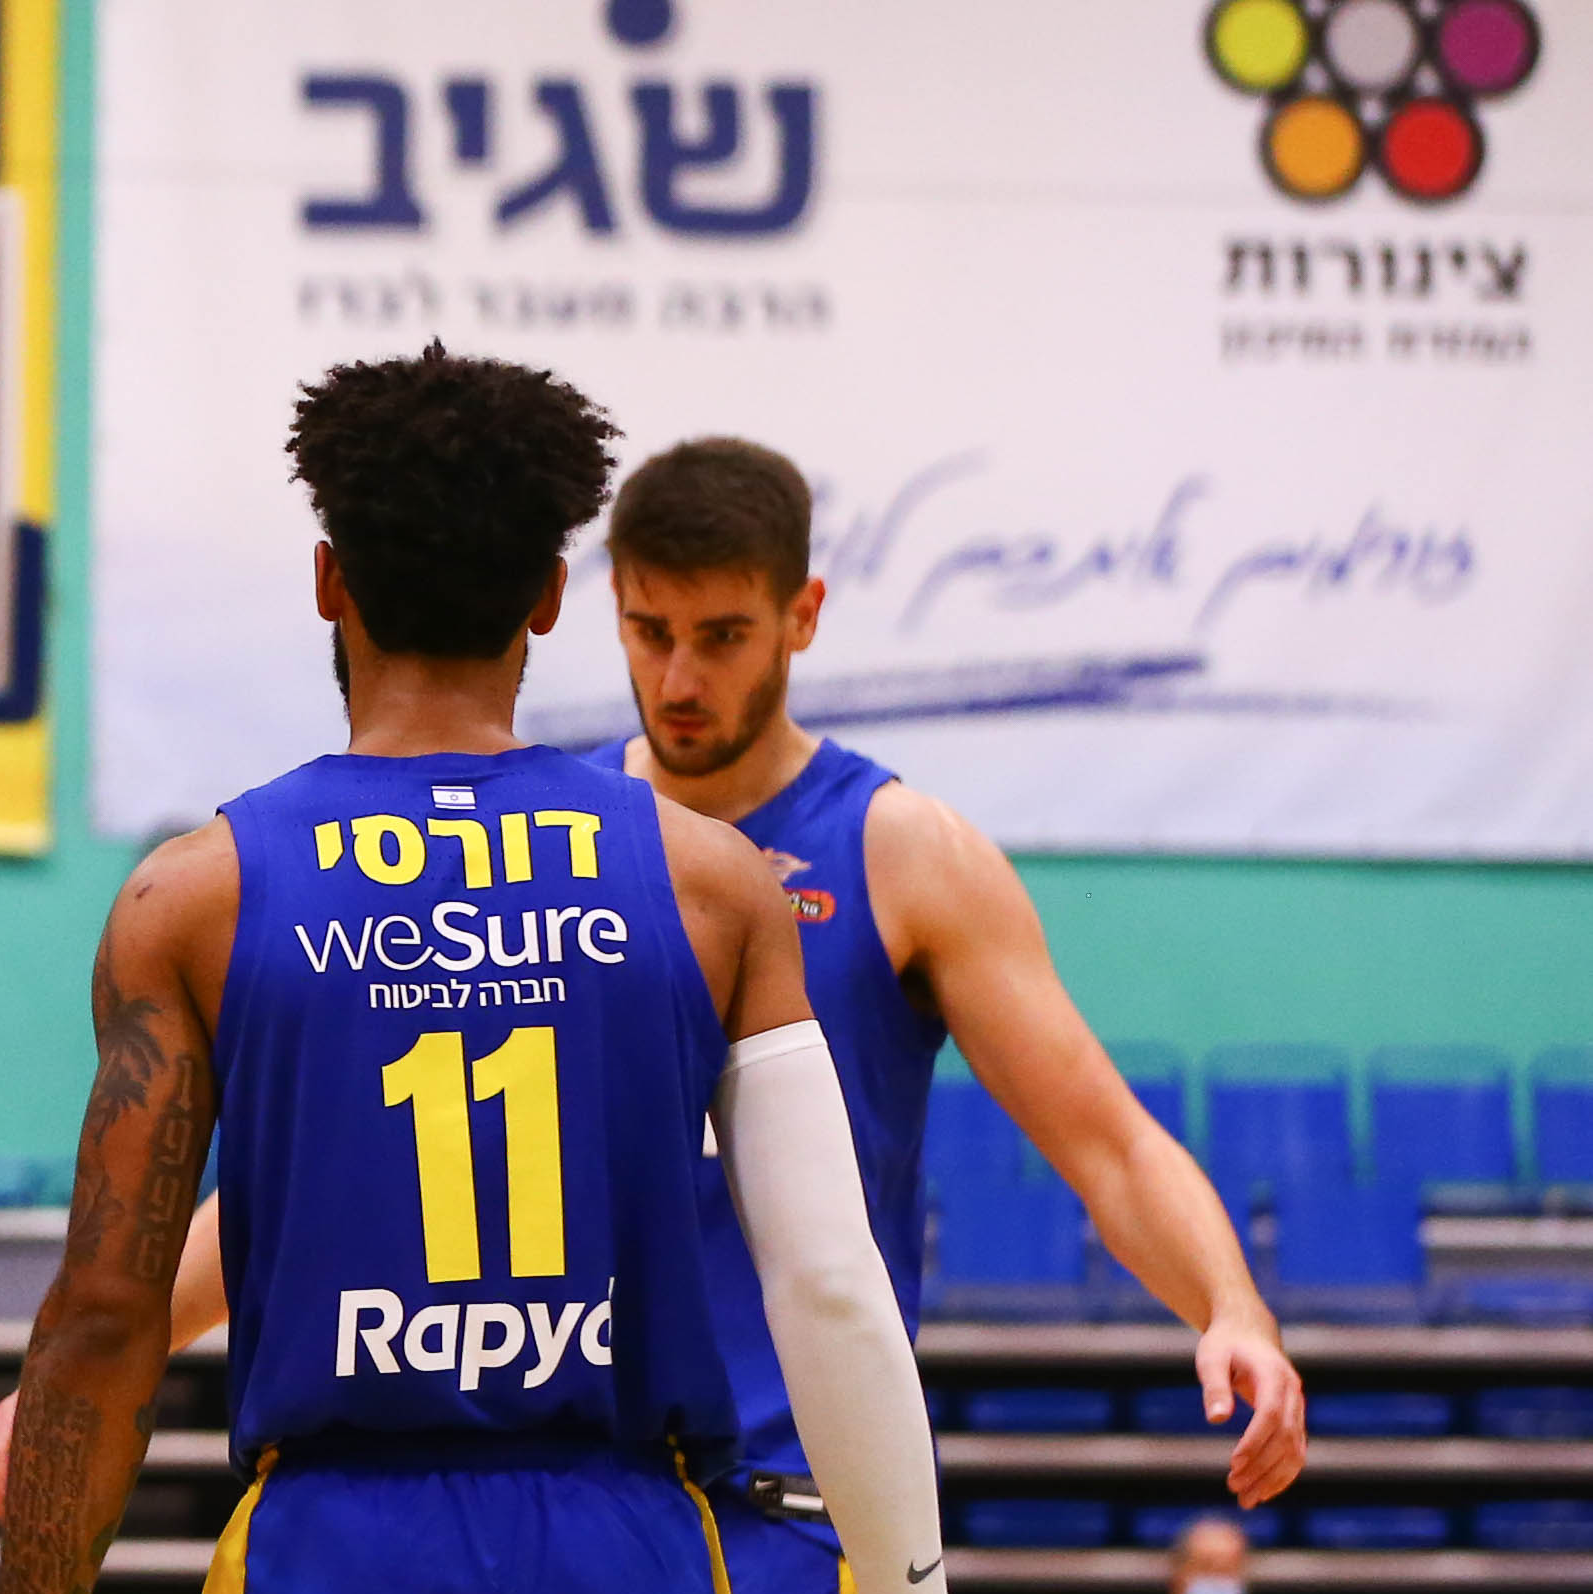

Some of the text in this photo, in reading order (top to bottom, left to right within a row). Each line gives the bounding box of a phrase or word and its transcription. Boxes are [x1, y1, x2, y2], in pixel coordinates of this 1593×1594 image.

[300, 76, 819, 237] שגיב
[1221, 238, 1528, 300] צינורות
[314, 808, 603, 889] דורסי
[294, 901, 629, 973] weSure
[369, 977, 566, 1010] חברה לביטוח
[381, 1025, 566, 1284] 11
[335, 1277, 615, 1391] Rapyd
